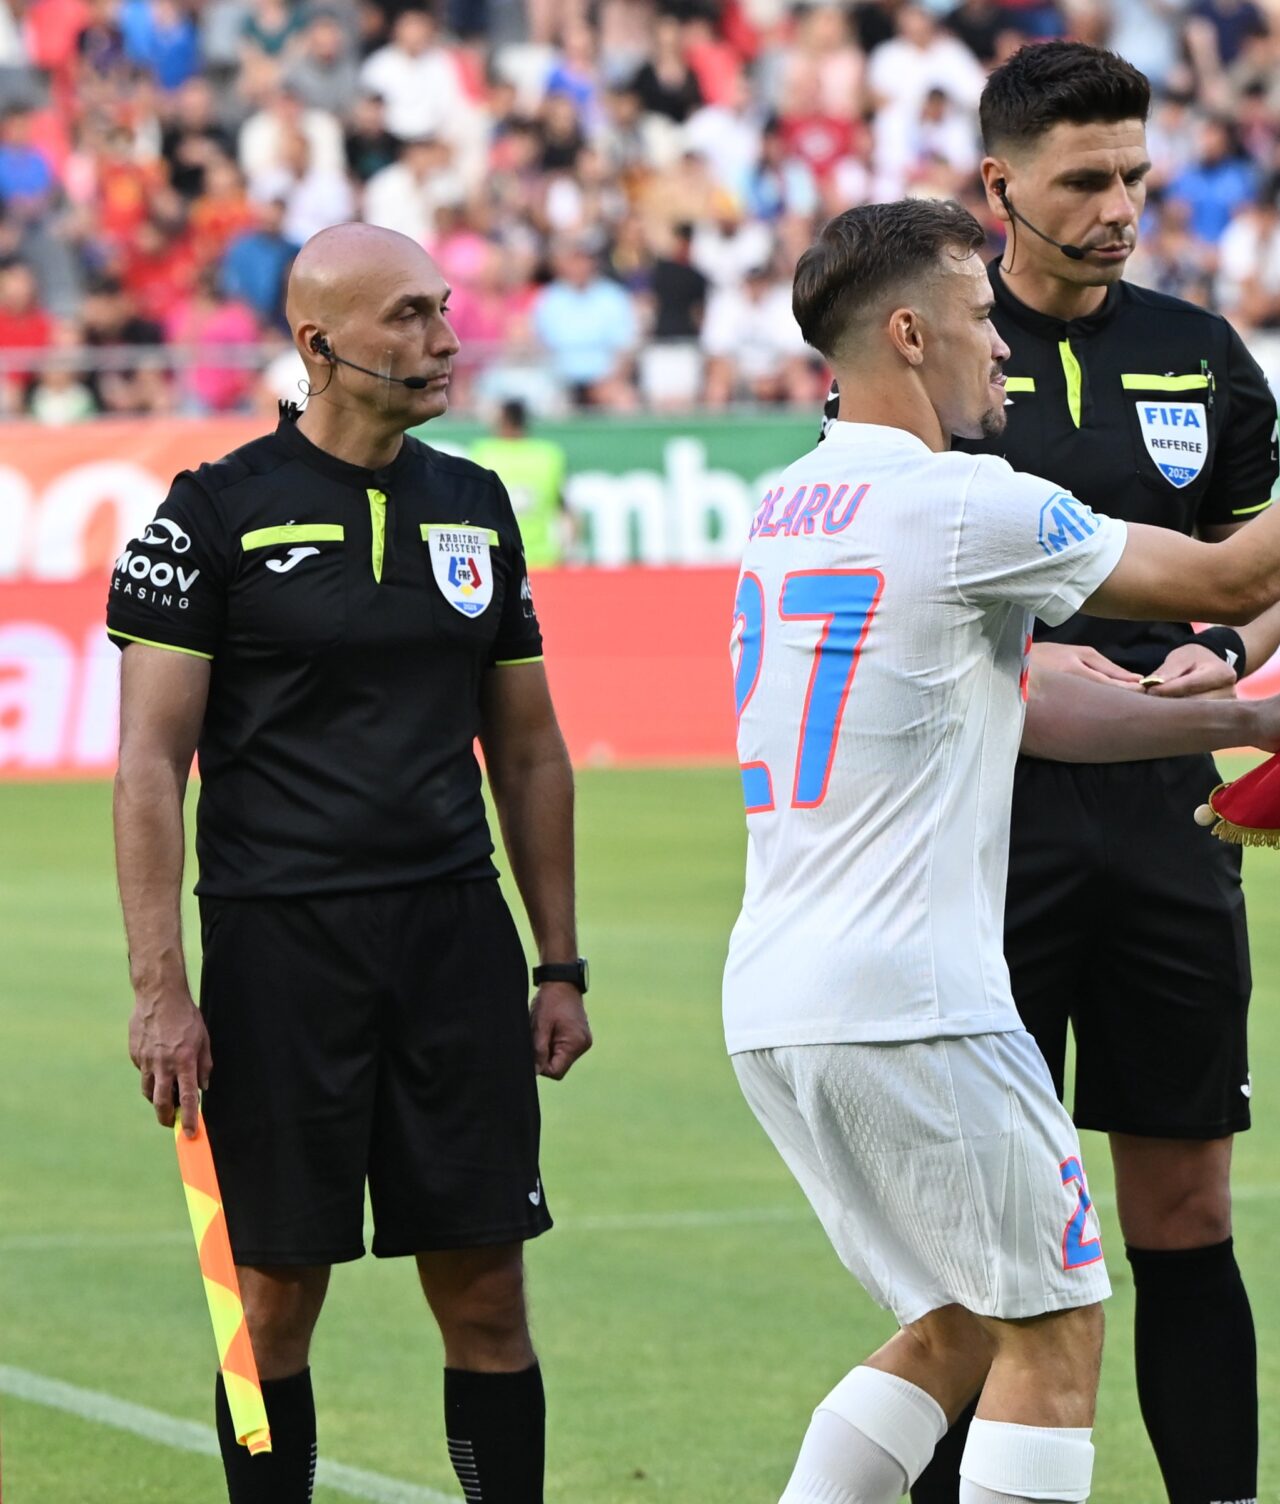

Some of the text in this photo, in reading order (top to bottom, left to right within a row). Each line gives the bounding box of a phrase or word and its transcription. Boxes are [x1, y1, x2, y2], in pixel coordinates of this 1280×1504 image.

[1144, 407, 1201, 429] FIFA
[1151, 438, 1203, 454] REFEREE
[1168, 466, 1191, 480] 2025
[439, 533, 479, 545] ARBITRU
[439, 543, 481, 555] ASISTENT
[457, 569, 471, 581] FRF
[111, 578, 189, 609] EASING
